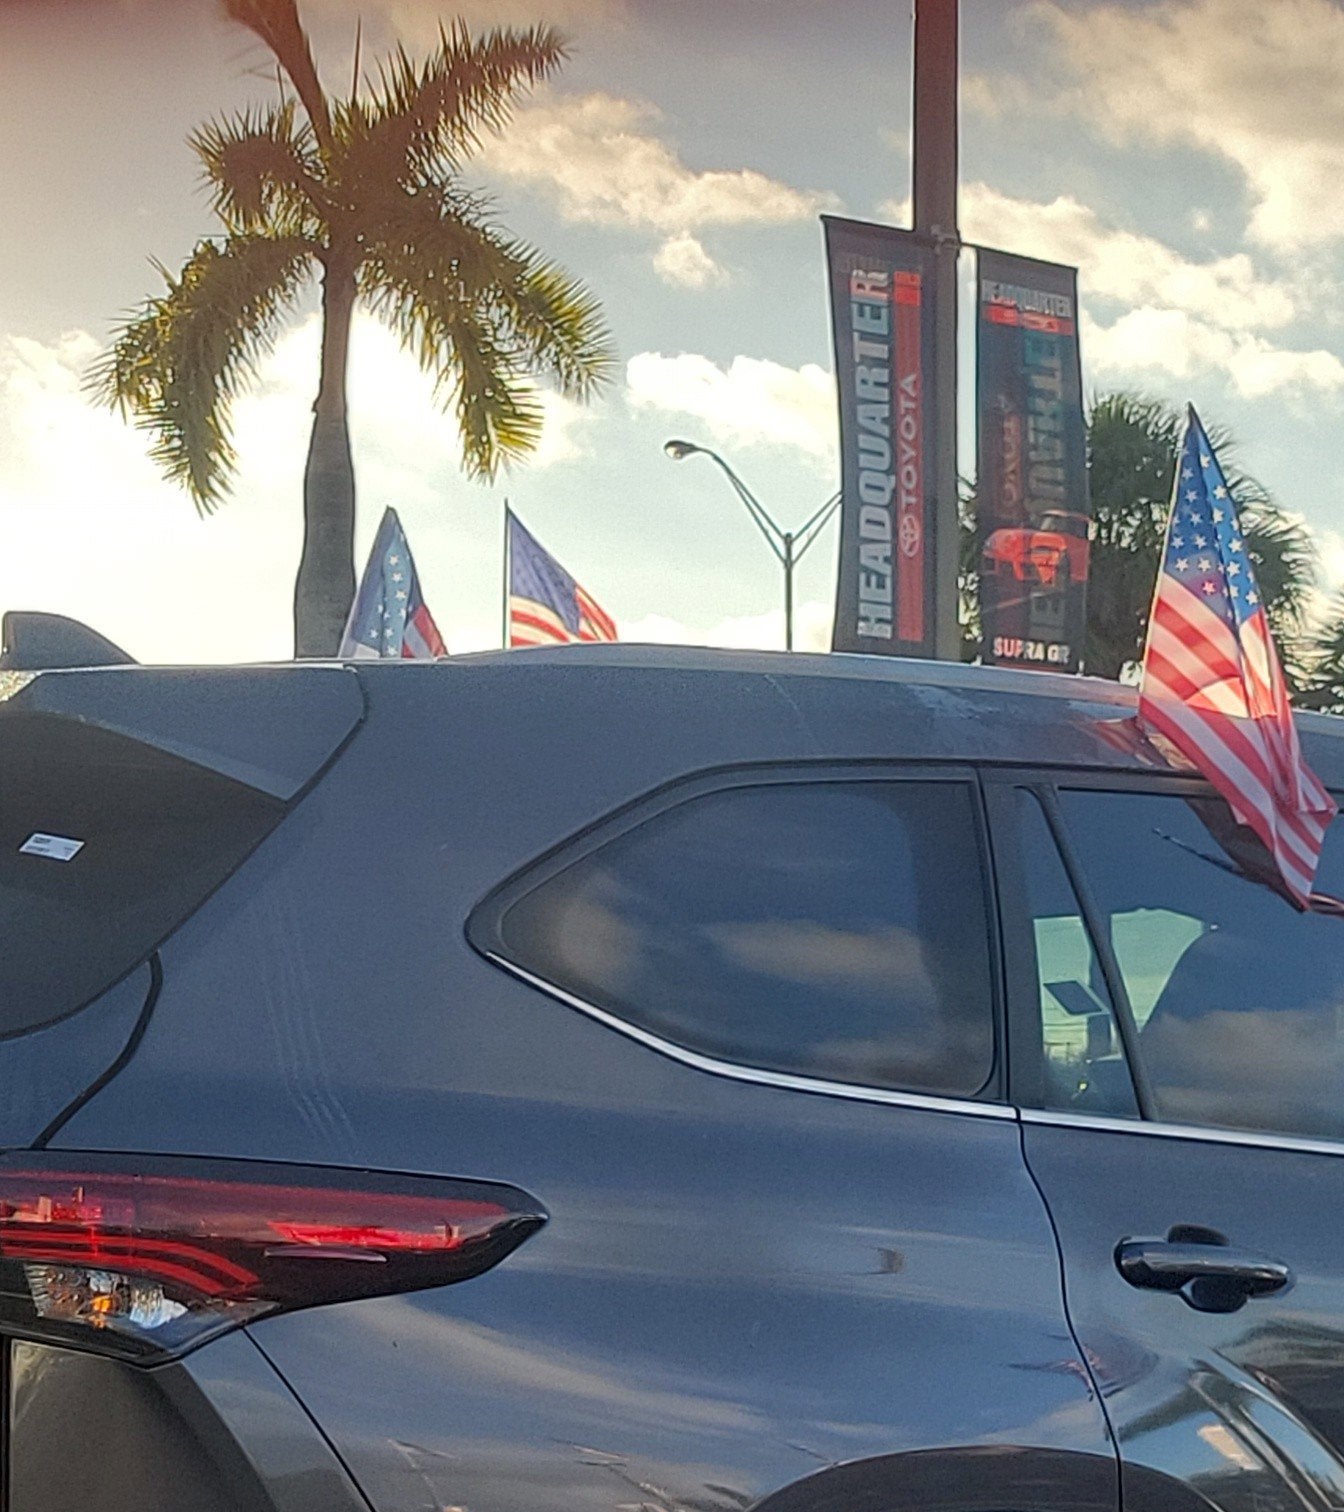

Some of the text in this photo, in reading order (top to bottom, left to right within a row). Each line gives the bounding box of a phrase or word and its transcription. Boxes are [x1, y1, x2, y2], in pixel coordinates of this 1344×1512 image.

[850, 268, 896, 640] HEADQUARTER
[900, 373, 918, 513] TOYOTA
[993, 636, 1071, 665] SUPRA GR
